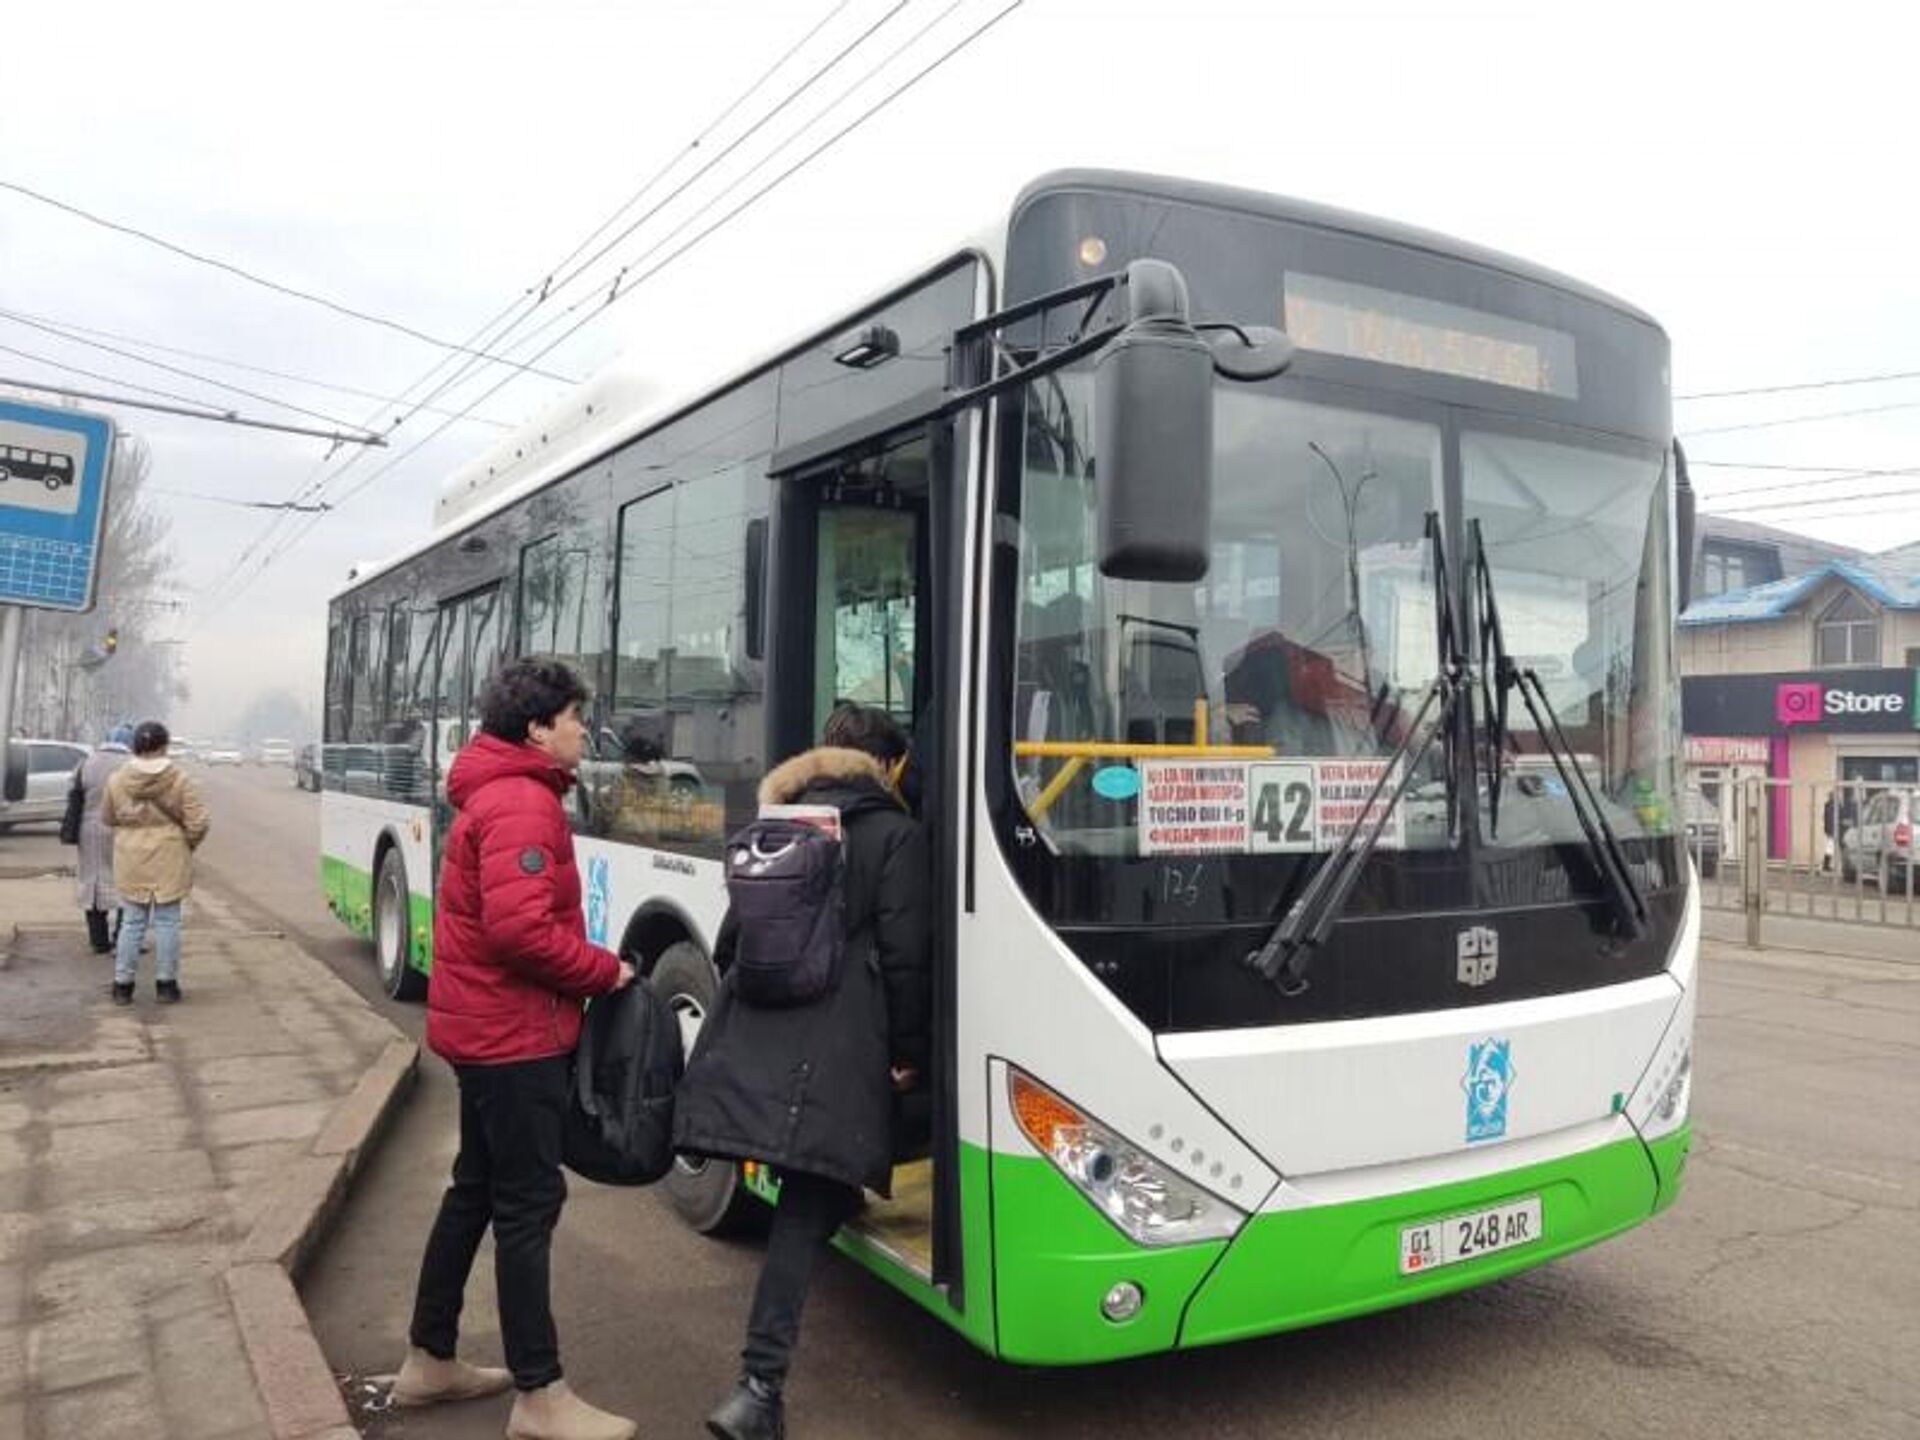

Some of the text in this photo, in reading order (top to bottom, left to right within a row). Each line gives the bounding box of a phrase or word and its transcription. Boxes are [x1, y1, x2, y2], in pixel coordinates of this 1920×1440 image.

[1824, 690, 1903, 714] Store
[1253, 782, 1312, 843] 42
[1459, 1211, 1529, 1255] 248 AR
